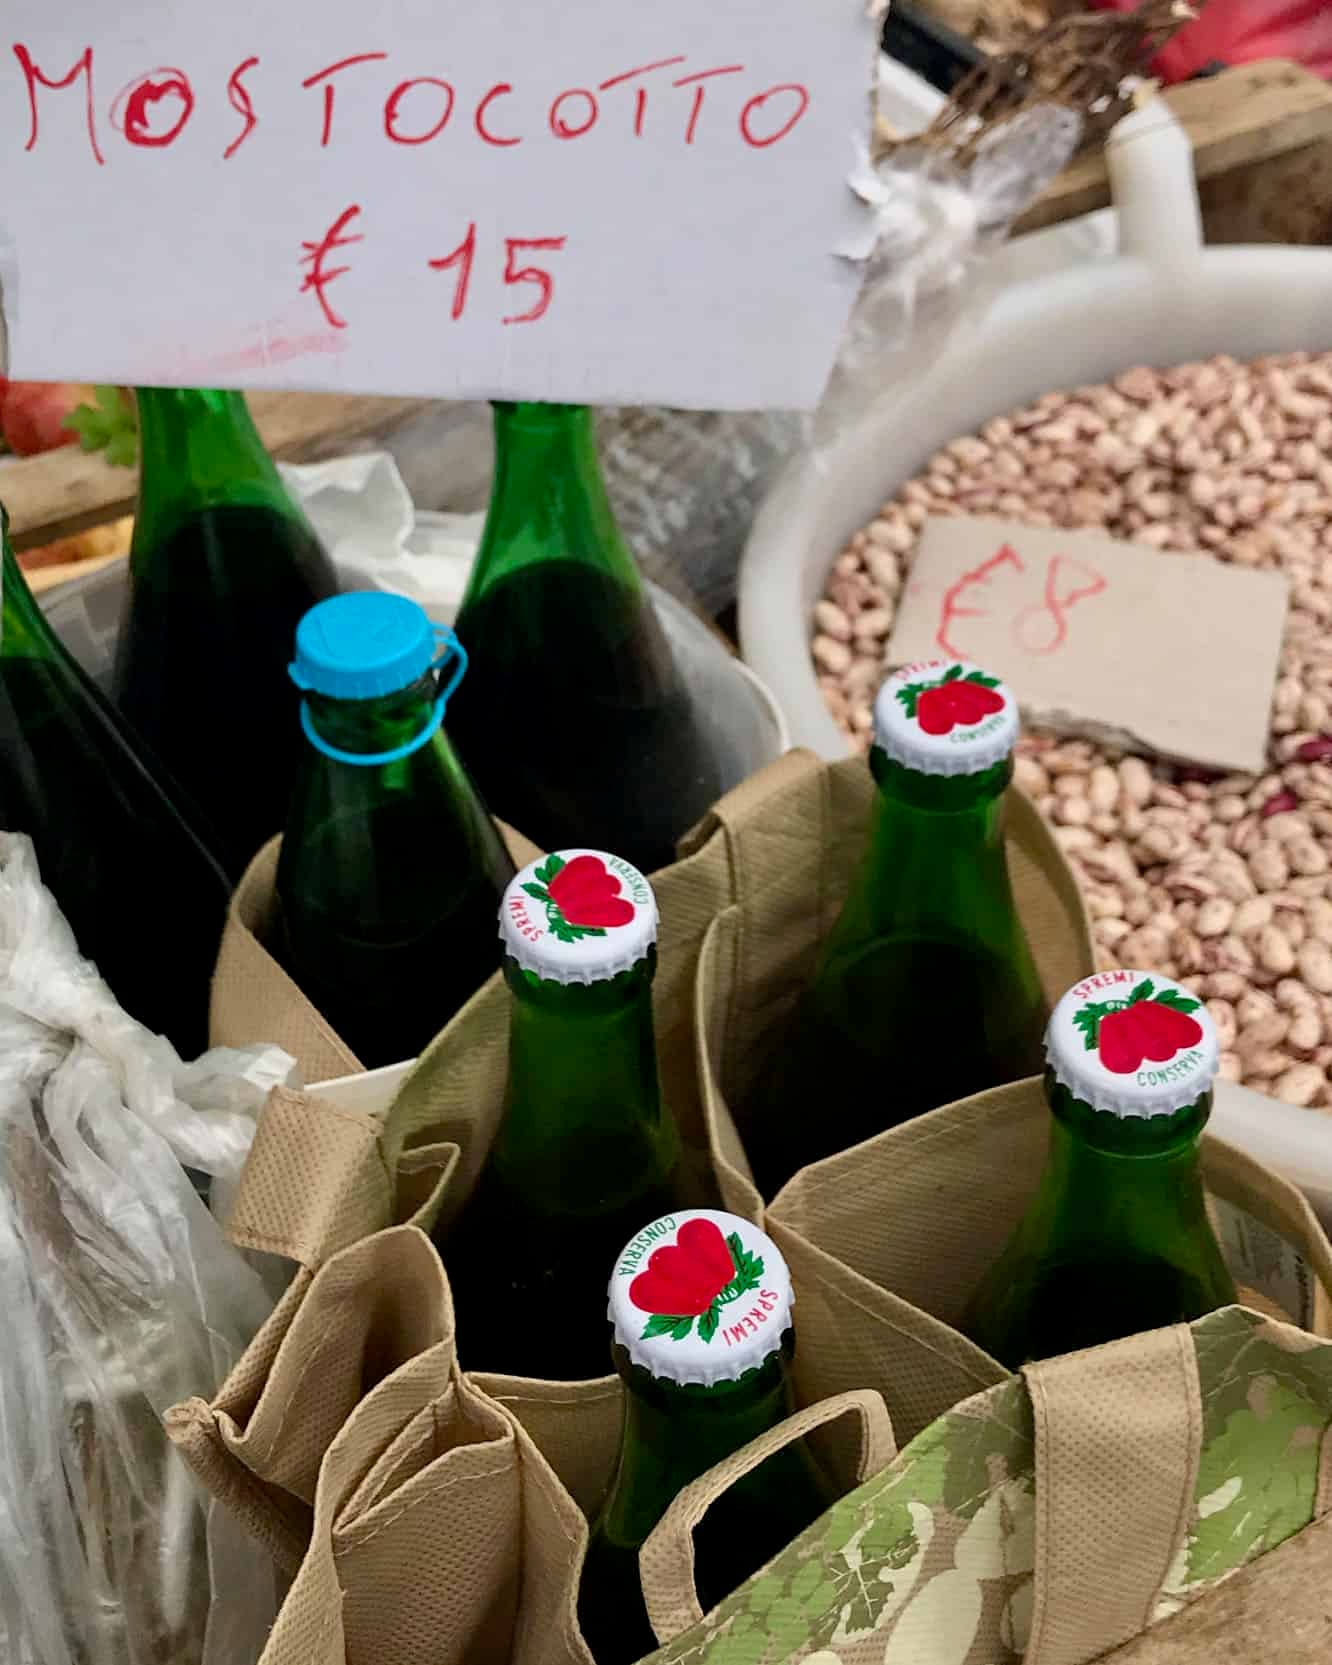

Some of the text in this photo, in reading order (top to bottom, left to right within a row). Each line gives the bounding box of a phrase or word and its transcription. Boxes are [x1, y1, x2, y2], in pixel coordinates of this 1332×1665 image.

[299, 204, 567, 329] € 15
[608, 856, 650, 905] CONSERVA
[509, 895, 544, 942] SPREMI
[1072, 970, 1136, 999] SPREMI
[1136, 1050, 1204, 1087] CONSERVA
[618, 1216, 677, 1276] CONSERVA
[722, 1288, 779, 1346] SPREMI
